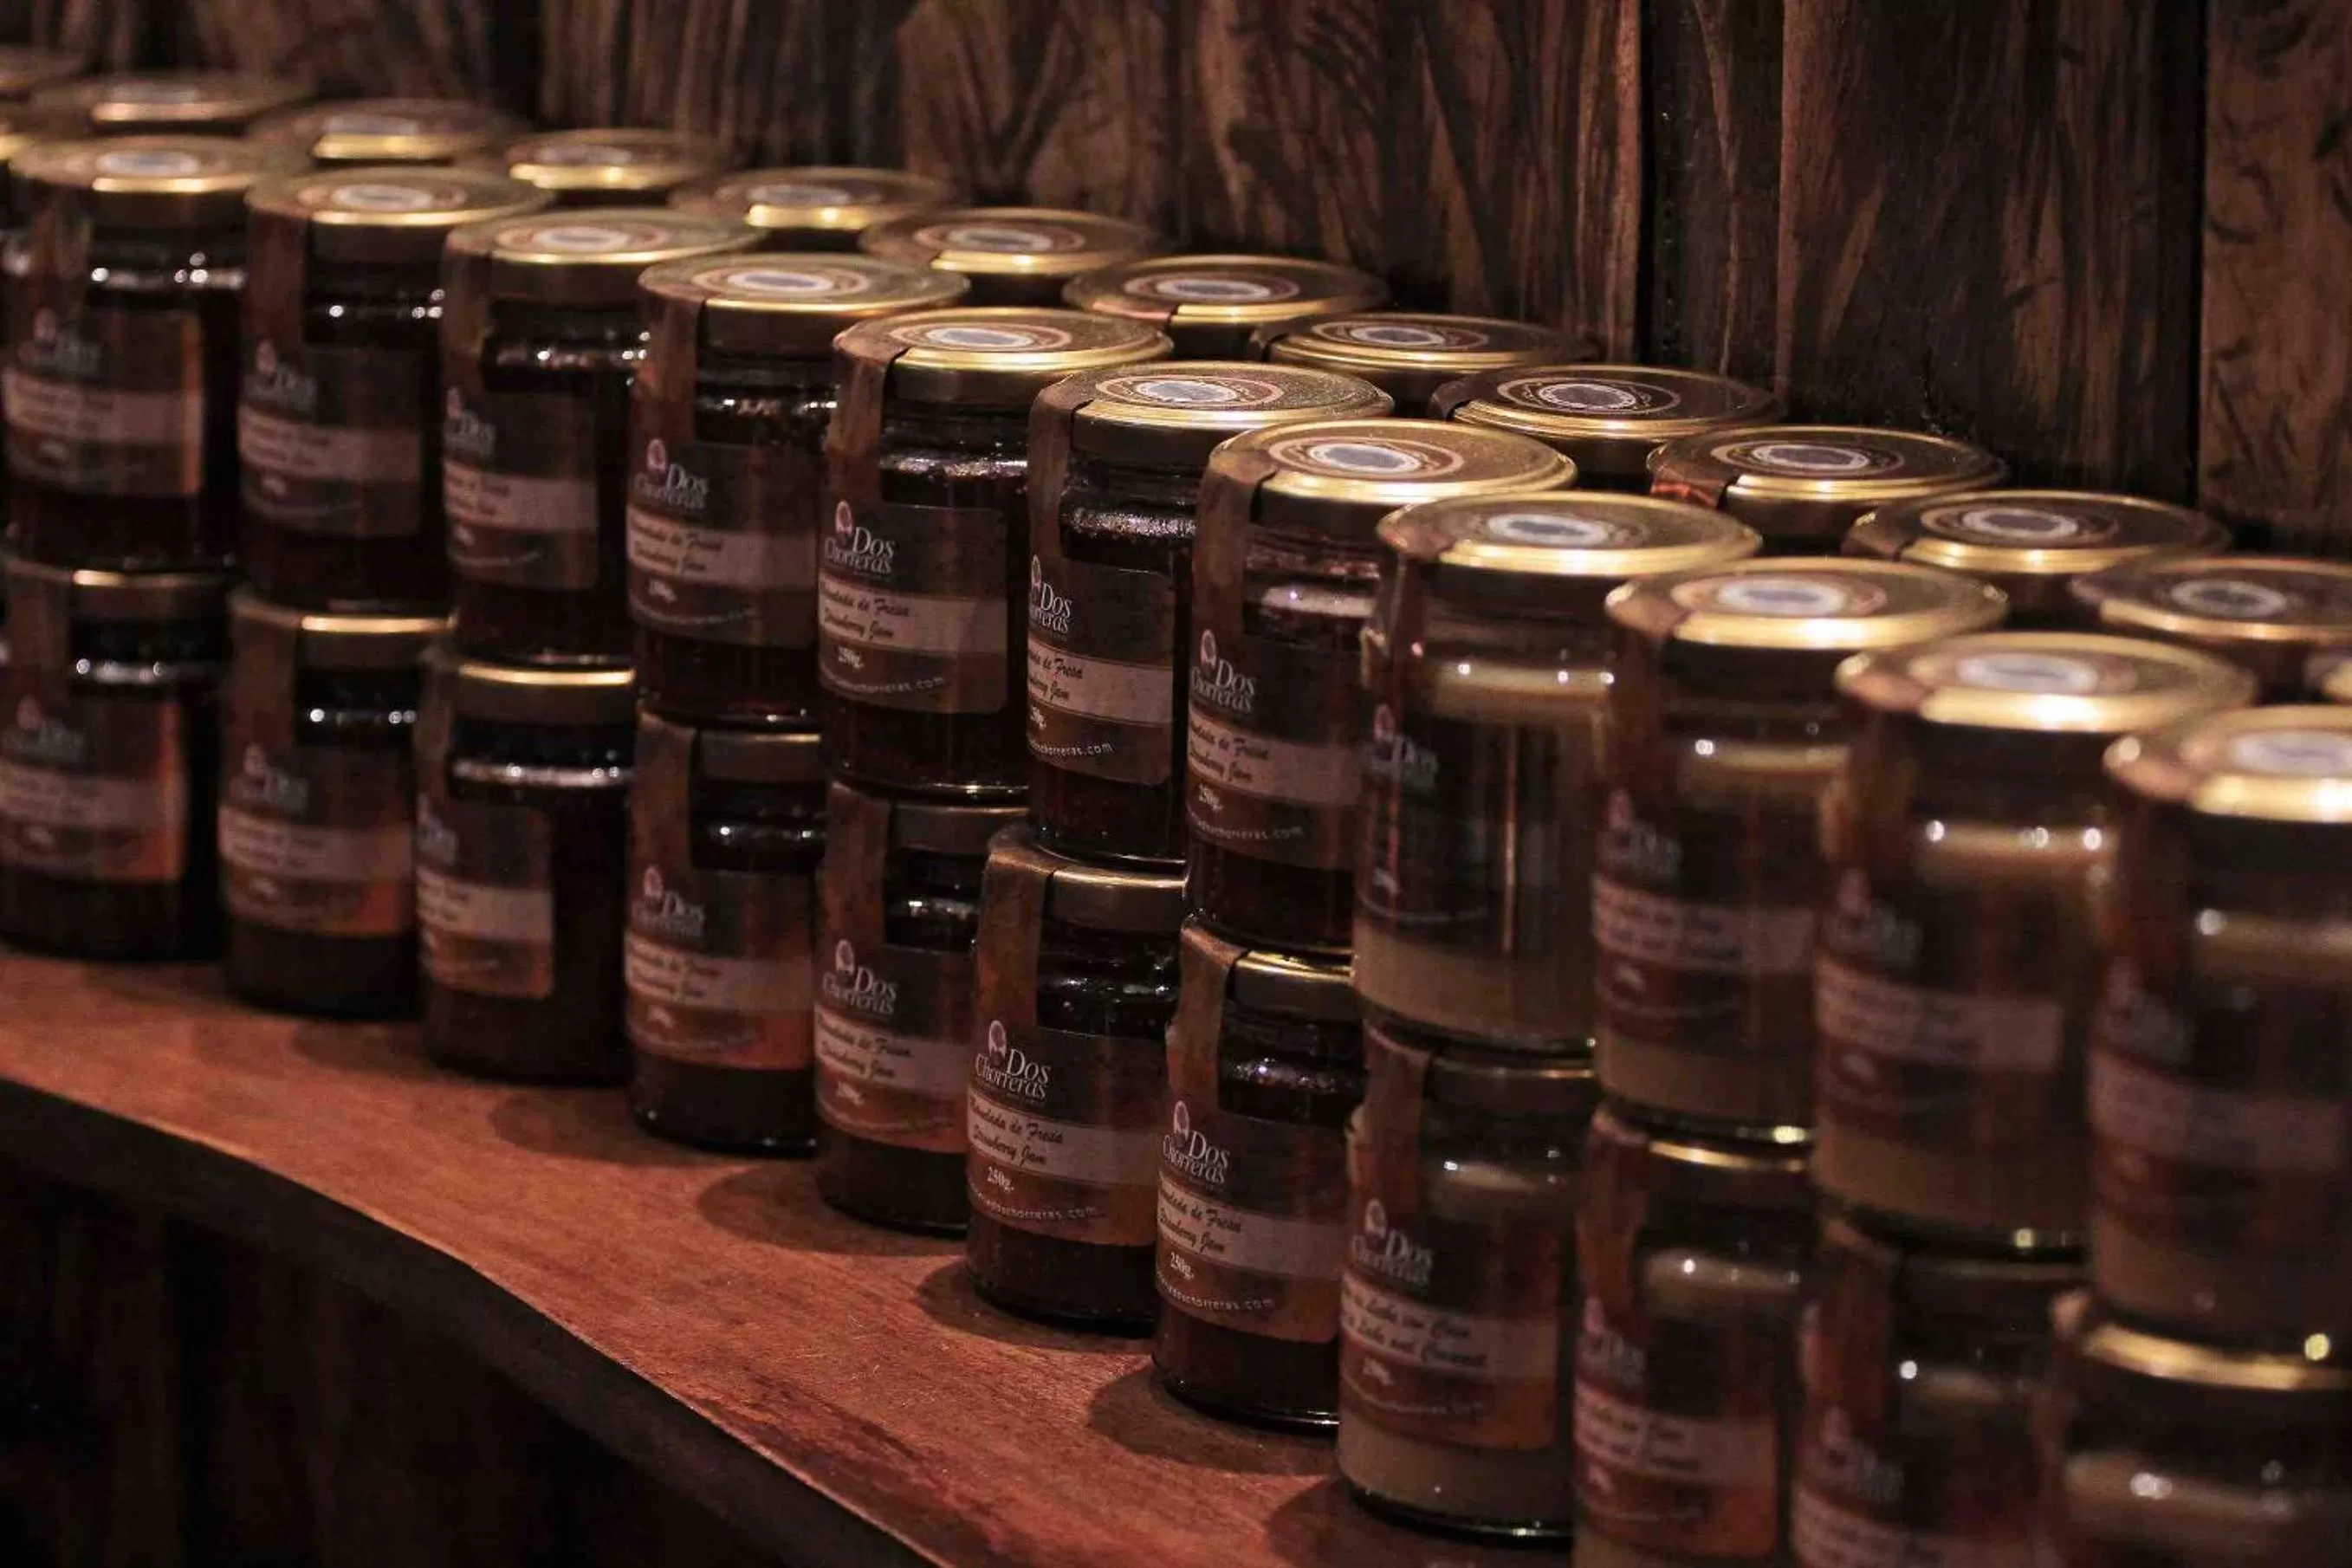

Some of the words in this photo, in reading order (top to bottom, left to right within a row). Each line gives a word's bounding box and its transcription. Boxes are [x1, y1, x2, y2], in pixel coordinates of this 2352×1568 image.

[852, 526, 896, 560] Dos
[1040, 582, 1073, 619] Dos
[1215, 658, 1256, 698] Dos
[854, 966, 899, 1002] Dos
[975, 1053, 1047, 1100] Chorreras
[1007, 1047, 1052, 1085] Dos
[1162, 1134, 1227, 1185] Chorreras
[1188, 1130, 1230, 1170] Dos
